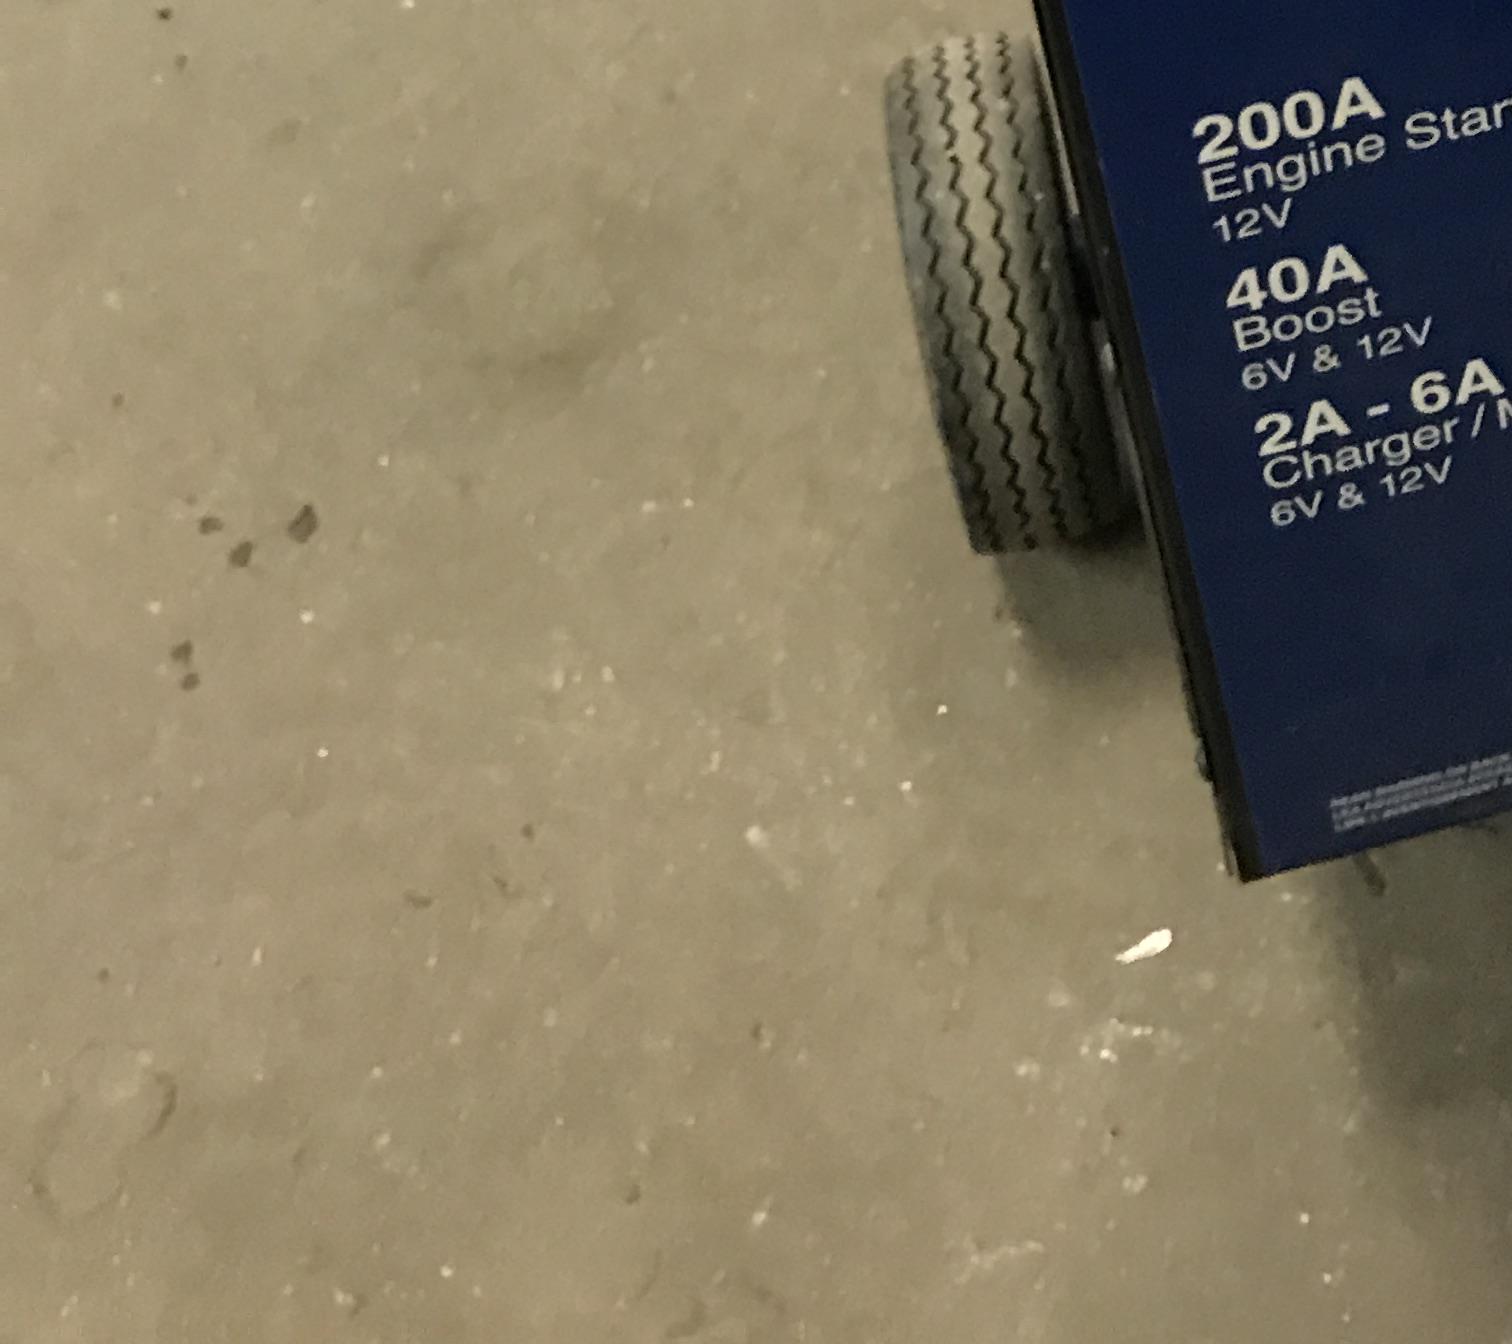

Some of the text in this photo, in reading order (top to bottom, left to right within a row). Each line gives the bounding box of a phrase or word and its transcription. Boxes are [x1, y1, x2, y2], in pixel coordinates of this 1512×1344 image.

[1191, 75, 1387, 164] 200A
[1200, 132, 1388, 203] Engine
[1211, 198, 1293, 243] 12V
[1225, 243, 1369, 312] 40A
[1231, 286, 1383, 353] Boost
[1240, 315, 1434, 392] 6V & 12V
[1253, 398, 1353, 458] 2A
[1409, 357, 1507, 414] 6A
[1269, 455, 1453, 528] 6V & 12V
